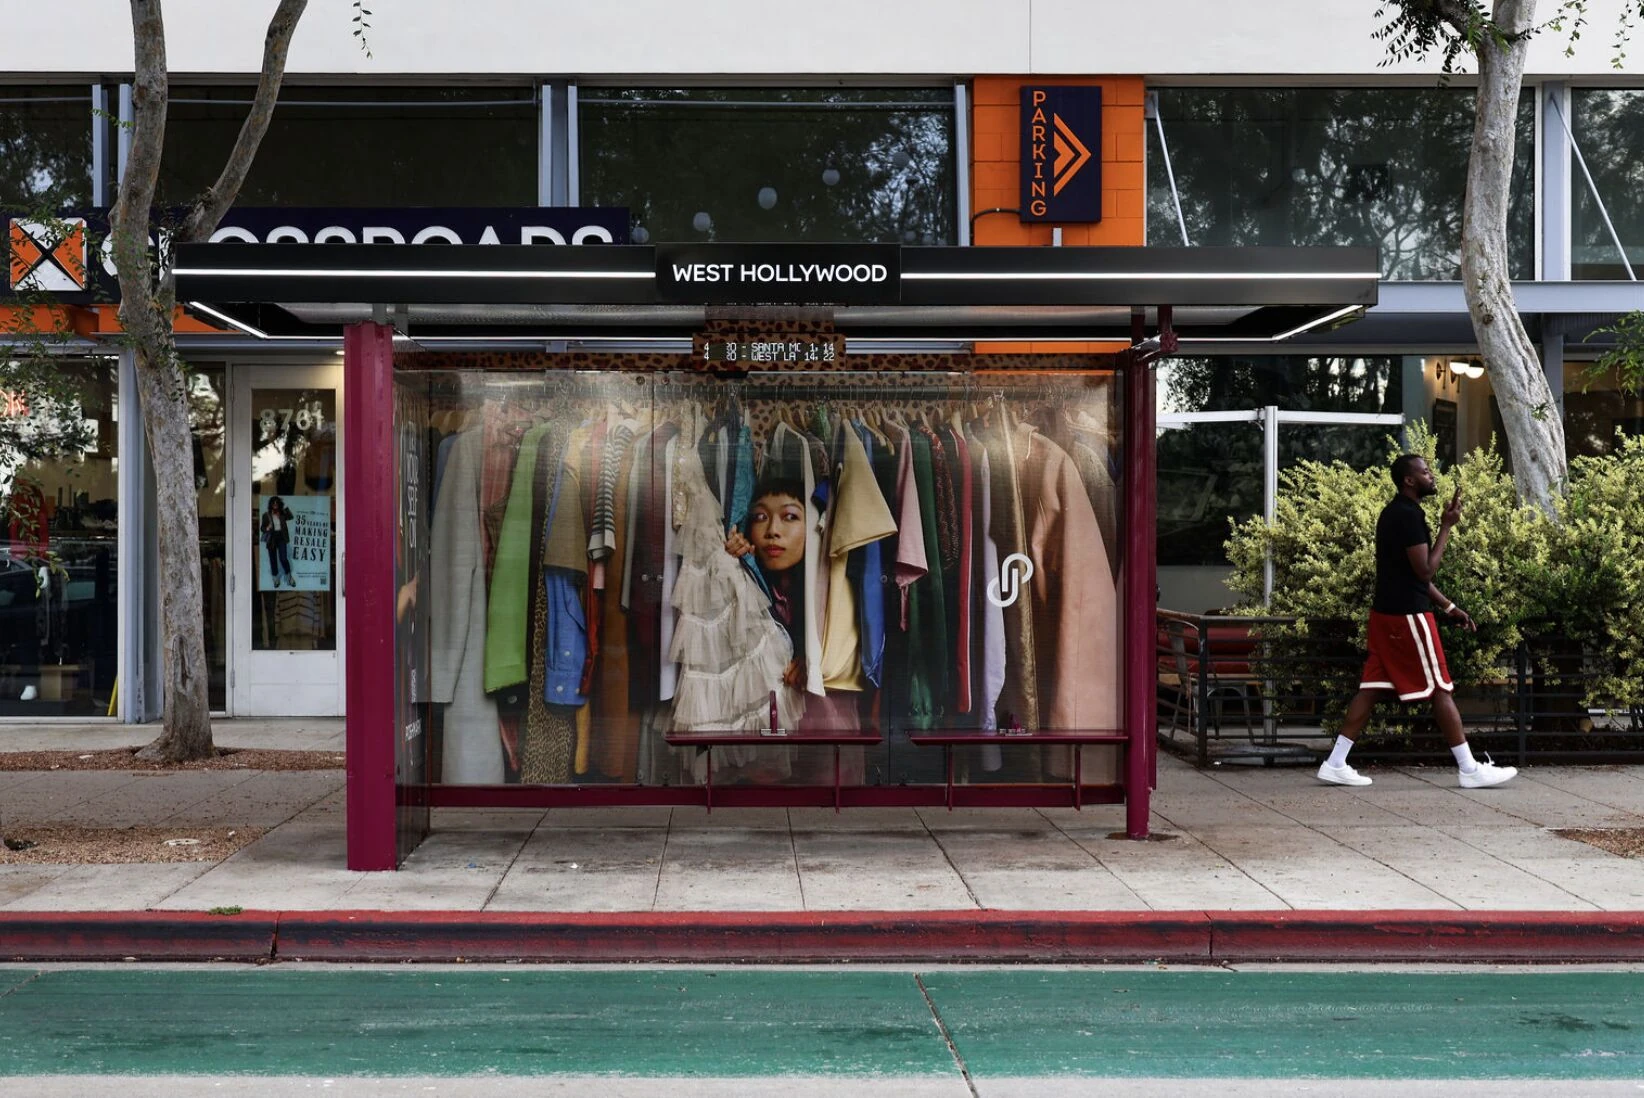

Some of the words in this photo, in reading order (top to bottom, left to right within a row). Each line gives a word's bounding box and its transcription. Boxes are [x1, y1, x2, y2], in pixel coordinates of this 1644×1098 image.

[1031, 90, 1047, 216] PARKING
[672, 263, 734, 283] WEST
[740, 263, 888, 283] HOLLYWOOD
[703, 342, 710, 352] 4
[751, 342, 785, 352] SANTA
[823, 342, 835, 352] 14
[703, 352, 710, 361] 4
[751, 352, 778, 361] WEST
[783, 352, 797, 361] LA
[823, 352, 836, 361] 22
[260, 408, 324, 431] 8761
[295, 514, 306, 526] 35
[295, 526, 328, 538] MAKING
[293, 535, 328, 548] RESALE
[292, 546, 326, 562] EASY
